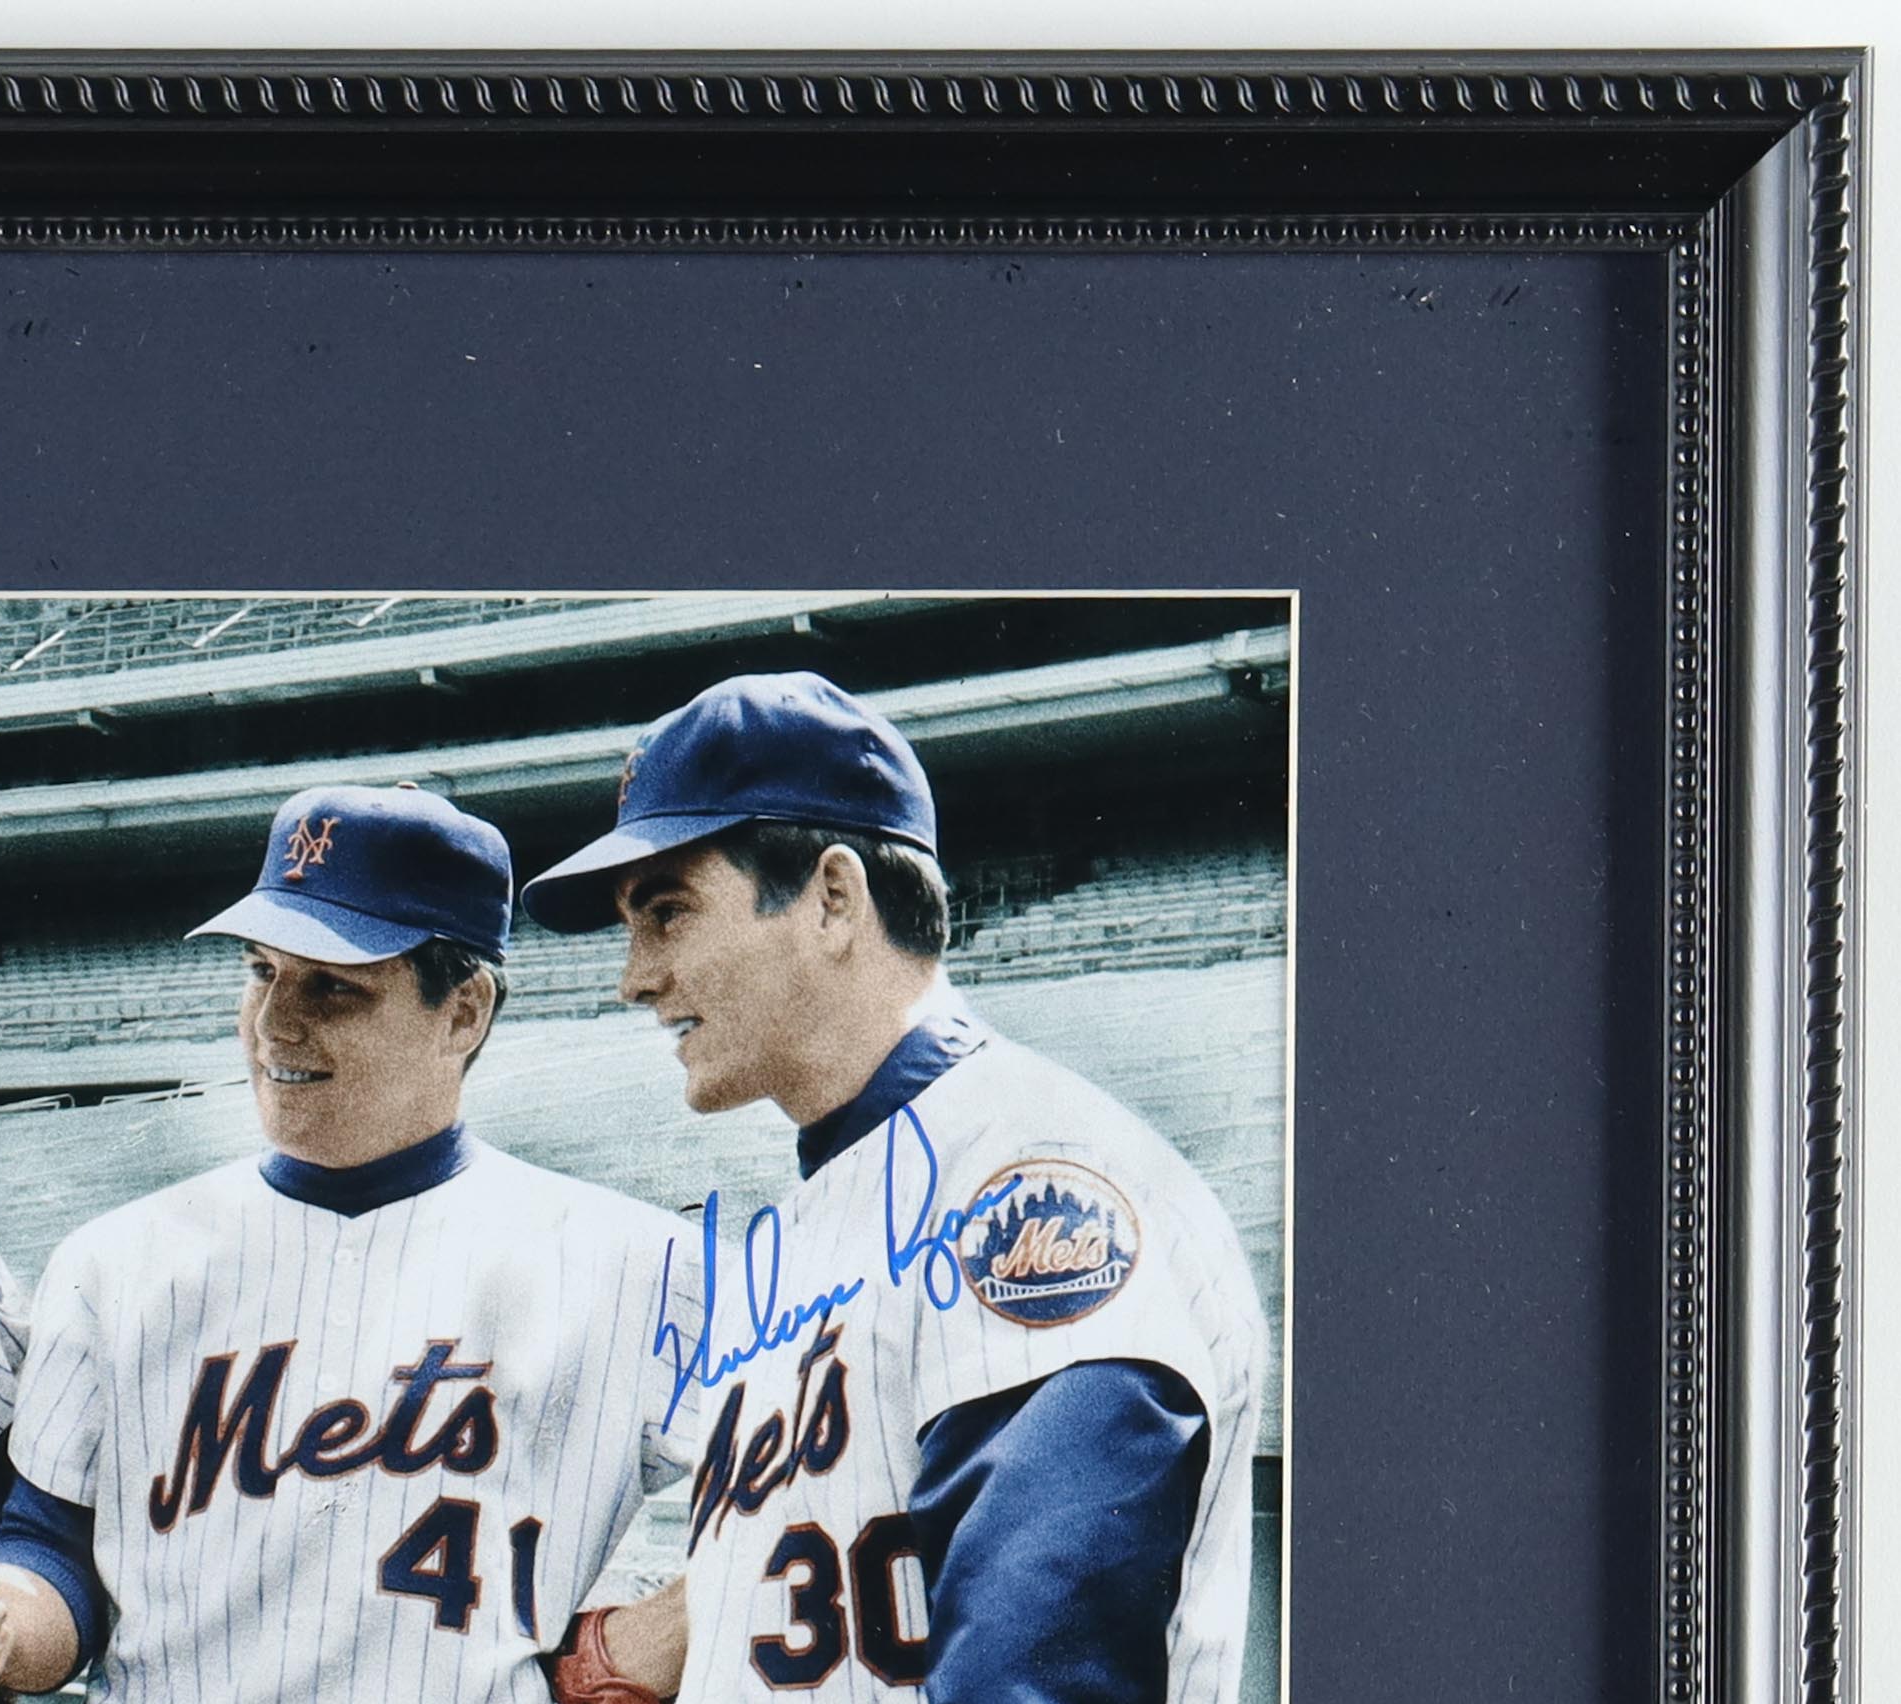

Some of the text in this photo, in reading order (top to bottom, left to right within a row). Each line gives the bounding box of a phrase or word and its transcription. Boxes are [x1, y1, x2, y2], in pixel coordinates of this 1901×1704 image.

[990, 1215, 1109, 1279] Mets
[148, 1337, 499, 1534] Mets
[376, 1494, 543, 1643] 41
[750, 1512, 931, 1690] 30
